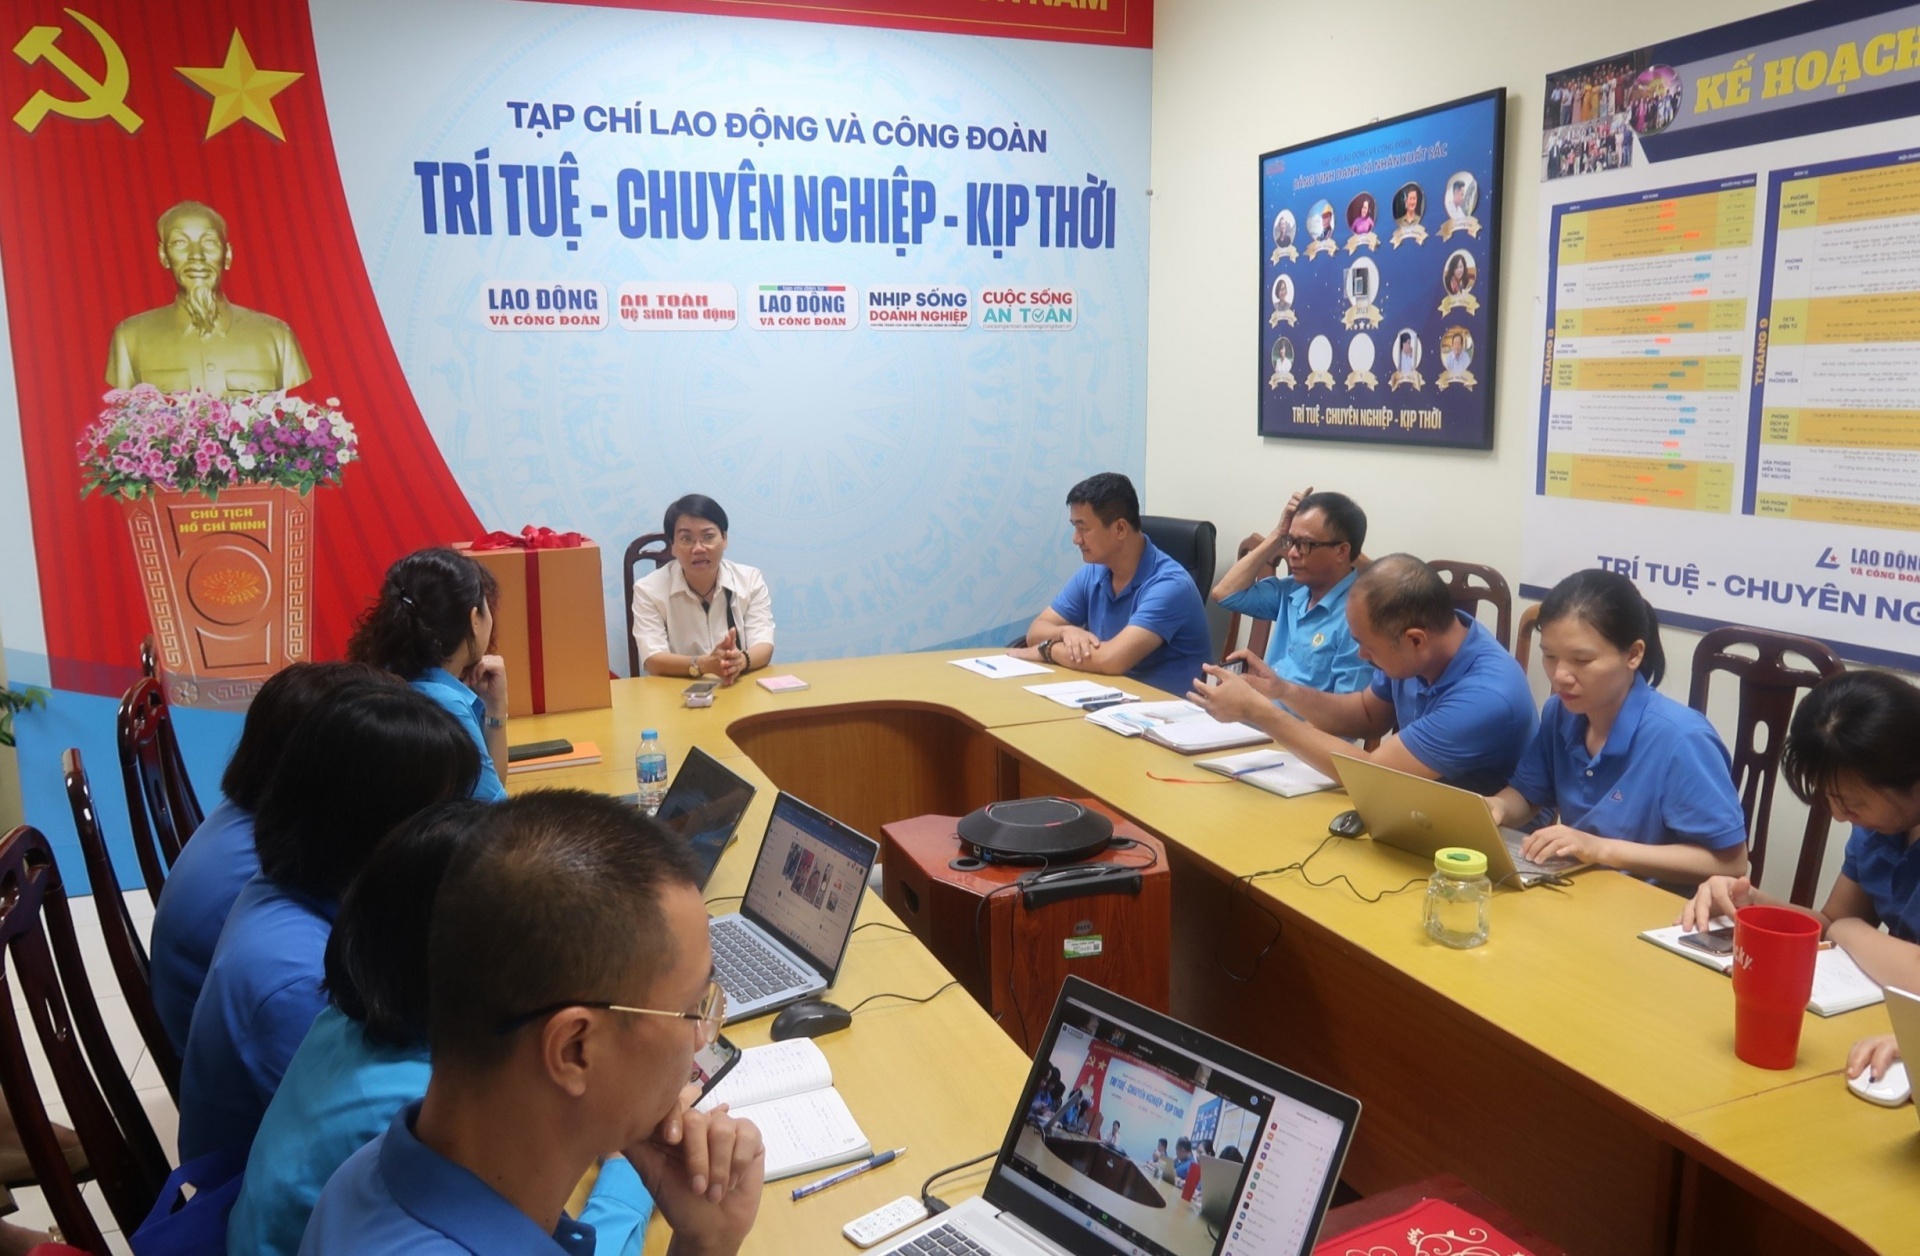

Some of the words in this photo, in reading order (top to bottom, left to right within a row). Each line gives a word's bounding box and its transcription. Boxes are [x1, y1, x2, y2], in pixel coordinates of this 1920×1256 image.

[1694, 52, 1756, 114] KẾ
[1761, 25, 1920, 99] HOẠCH
[506, 101, 575, 139] TẠP
[583, 100, 642, 134] CHÍ
[649, 109, 717, 137] LAO
[725, 107, 818, 148] ĐỘNG
[825, 112, 866, 144] VÀ
[873, 115, 960, 149] CÔNG
[966, 122, 1047, 153] ĐOÀN
[1316, 169, 1336, 186] VINH
[1336, 164, 1360, 181] DANH
[414, 147, 492, 235] TRÍ
[499, 151, 582, 251] TUỆ
[617, 158, 785, 241] CHUYÊN
[794, 165, 936, 257] NGHIỆP
[967, 182, 1030, 259] KỊP
[1036, 172, 1116, 249] THỜI
[488, 288, 530, 310] LAO
[535, 284, 598, 313] ĐỘNG
[621, 294, 649, 307] AN
[759, 295, 791, 313] LAO
[796, 292, 845, 315] ĐỘNG
[869, 292, 912, 310] NHỊP
[916, 288, 967, 307] SỐNG
[982, 288, 1026, 307] CUỘC
[1030, 288, 1072, 305] SỐNG
[489, 313, 509, 326] VÀ
[513, 313, 555, 326] CÔNG
[559, 313, 600, 326] ĐOÀN
[620, 308, 639, 322] Vệ
[643, 308, 673, 320] sinh
[678, 308, 699, 320] lao
[703, 308, 736, 322] động
[778, 316, 811, 326] CÔNG
[814, 316, 846, 326] ĐOÀN
[869, 310, 917, 321] DOANH
[921, 309, 968, 324] NGHIỆP
[983, 308, 1012, 323] AN
[1543, 339, 1554, 386] THÁNG
[1754, 332, 1768, 386] THÁNG
[1292, 403, 1304, 424] TRÍ
[1306, 403, 1320, 427] TUỆ
[1325, 405, 1359, 426] CHUYÊN
[1360, 405, 1393, 430] NGHIỆP
[1400, 409, 1417, 431] KỊP
[1418, 406, 1442, 429] THỜI
[190, 506, 219, 520] CHỦ
[222, 508, 253, 520] TỊCH
[202, 520, 226, 532] CHÍ
[229, 520, 266, 531] MINH
[1851, 548, 1880, 566] LAO
[1884, 550, 1920, 572] ĐỘN
[1865, 568, 1896, 580] CÔNG
[1597, 555, 1640, 580] TRÍ
[1645, 562, 1700, 596] TUỆ
[1724, 574, 1867, 617] CHUYÊN
